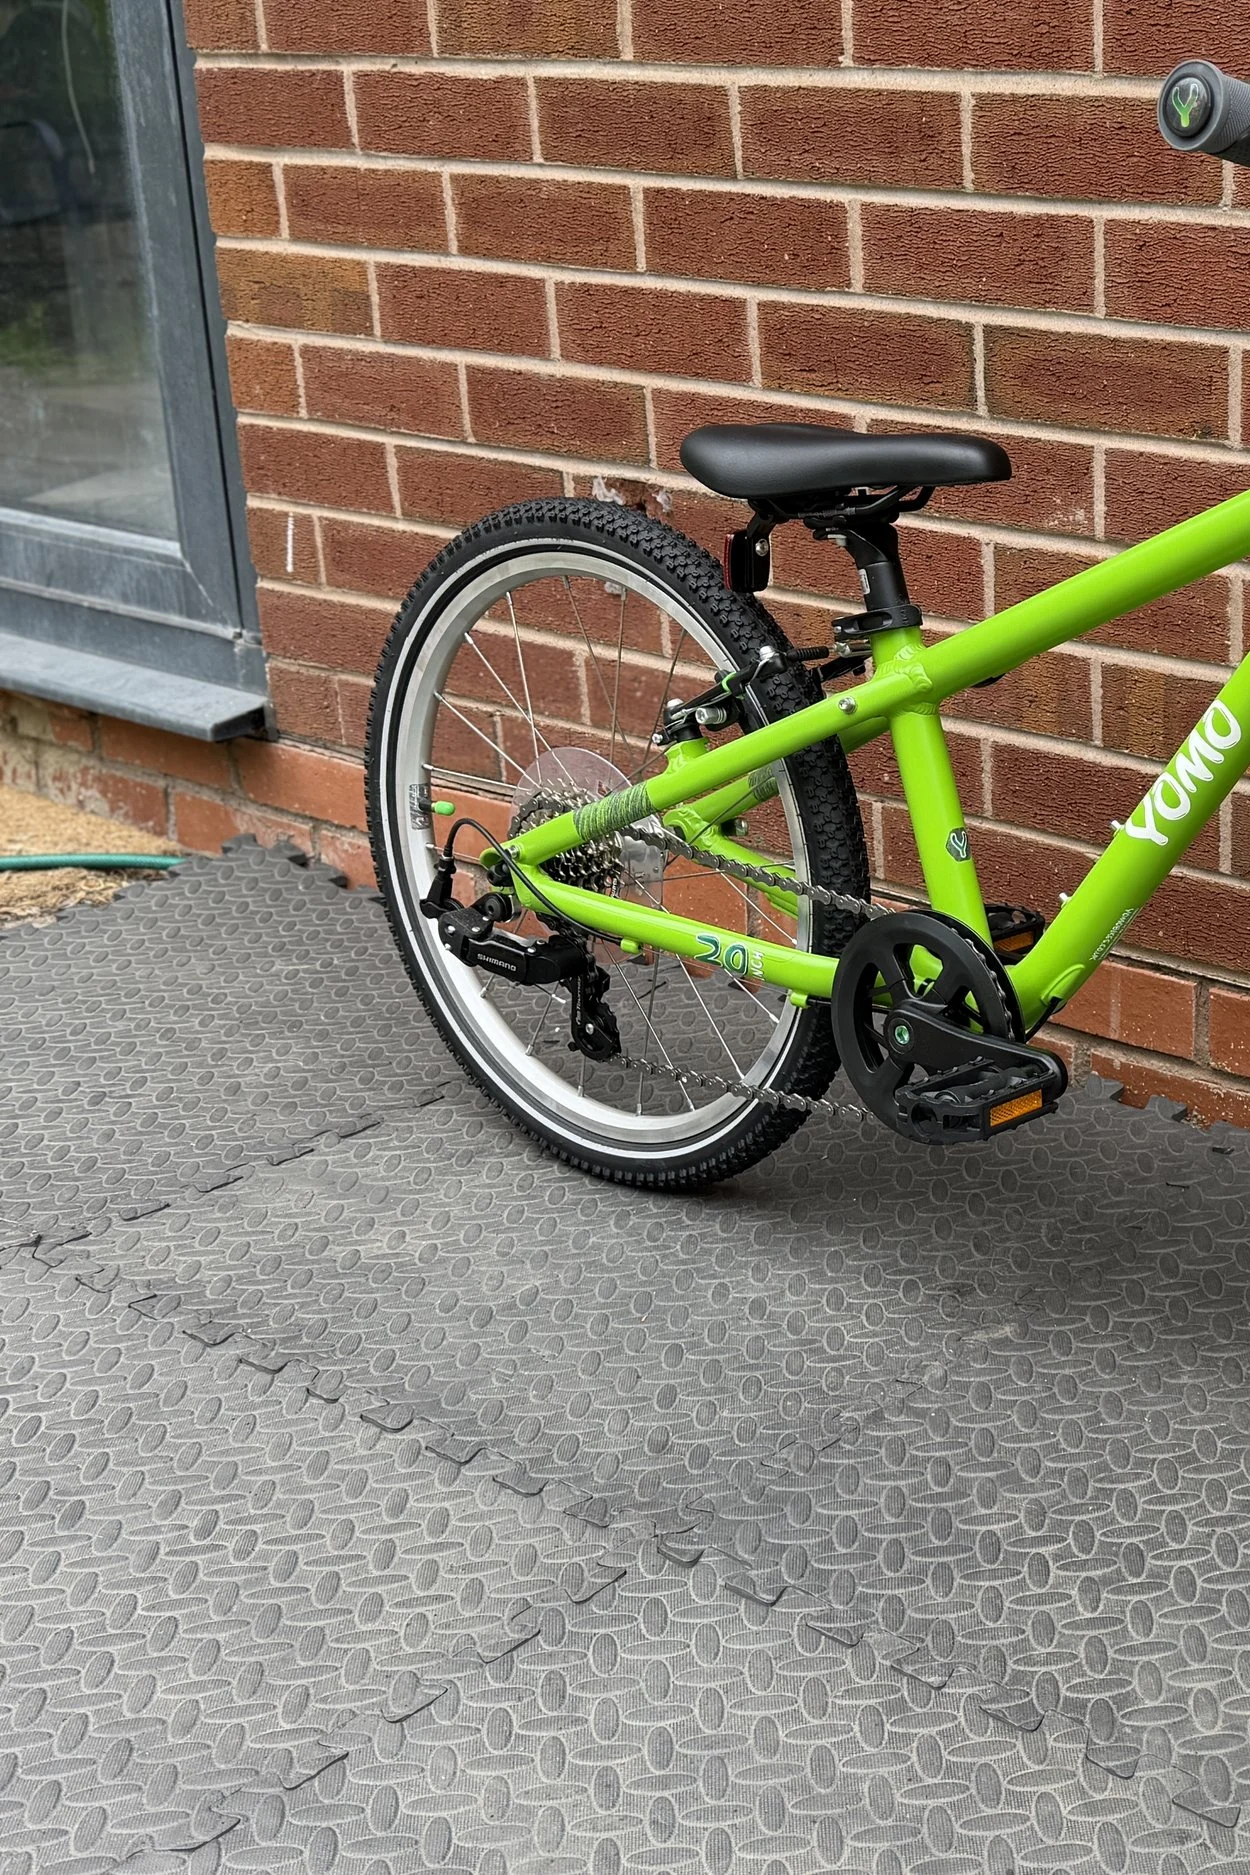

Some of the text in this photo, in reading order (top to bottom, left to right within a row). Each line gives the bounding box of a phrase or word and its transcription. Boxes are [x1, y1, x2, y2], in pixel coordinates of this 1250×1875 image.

[1125, 700, 1242, 846] YOMO
[477, 953, 517, 972] SHIMANO
[694, 932, 766, 981] 20 INCH
